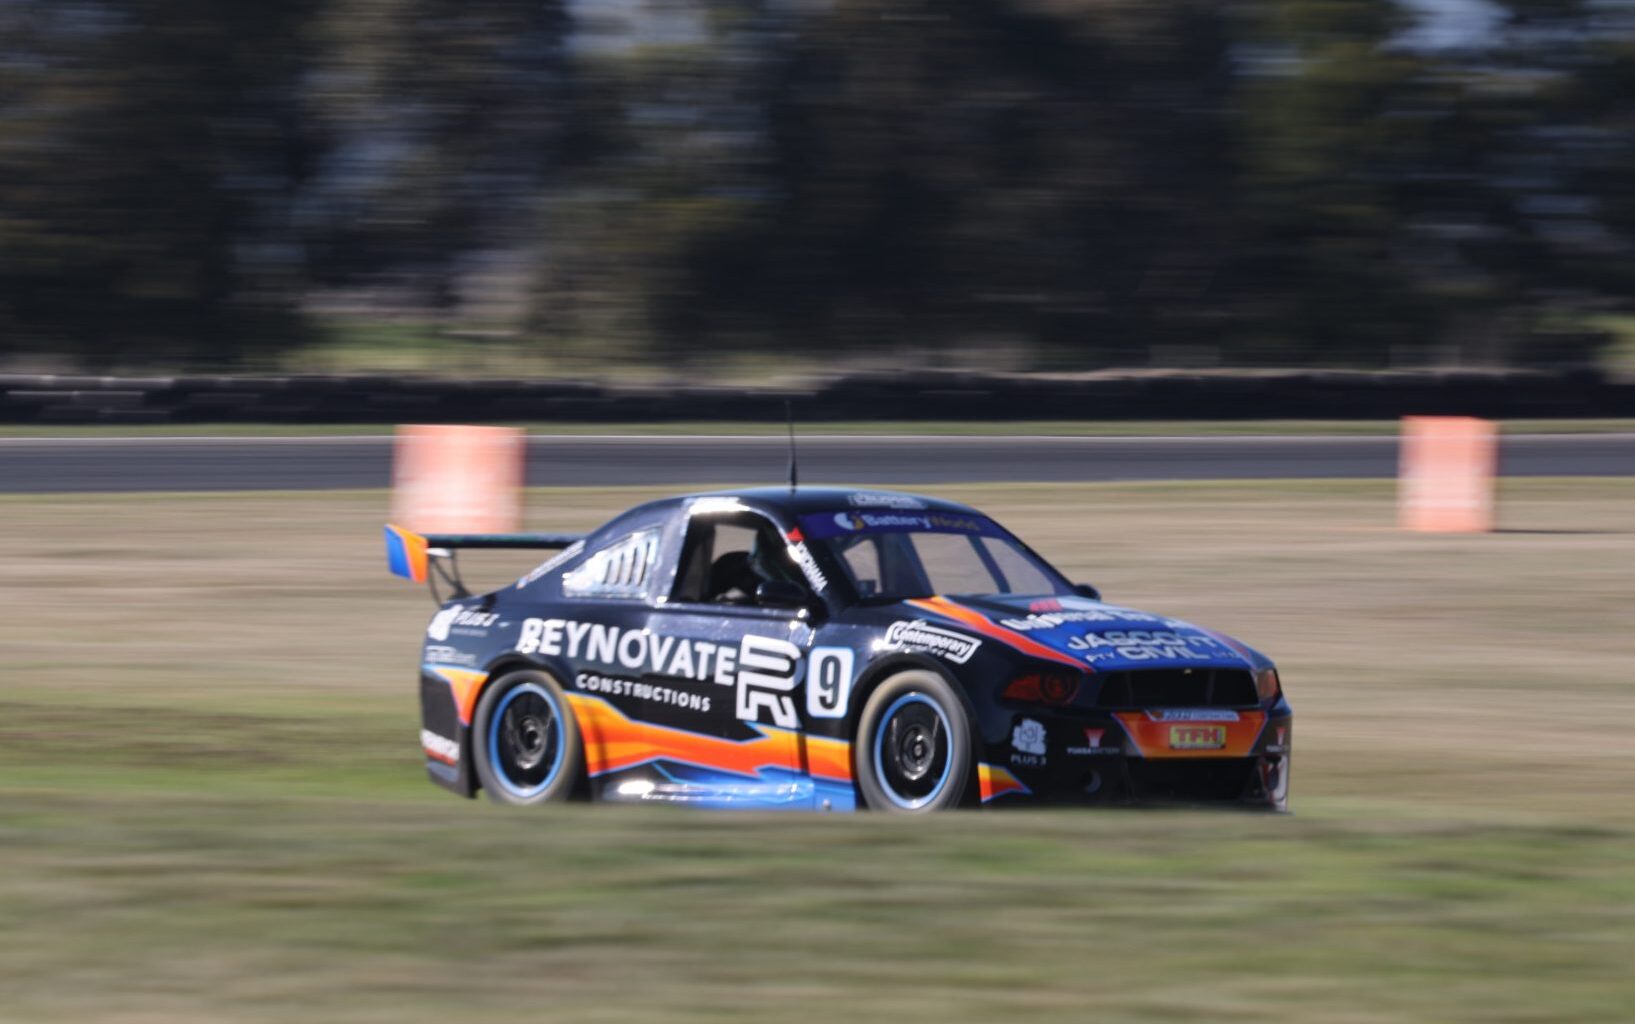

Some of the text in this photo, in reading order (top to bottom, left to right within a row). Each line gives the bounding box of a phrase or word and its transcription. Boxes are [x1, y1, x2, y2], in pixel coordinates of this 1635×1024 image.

[861, 514, 932, 529] Battery
[893, 626, 973, 657] Contemporary
[1116, 646, 1211, 660] CIVIL
[576, 673, 711, 711] CONSTRUCTIONS
[819, 655, 841, 710] 9
